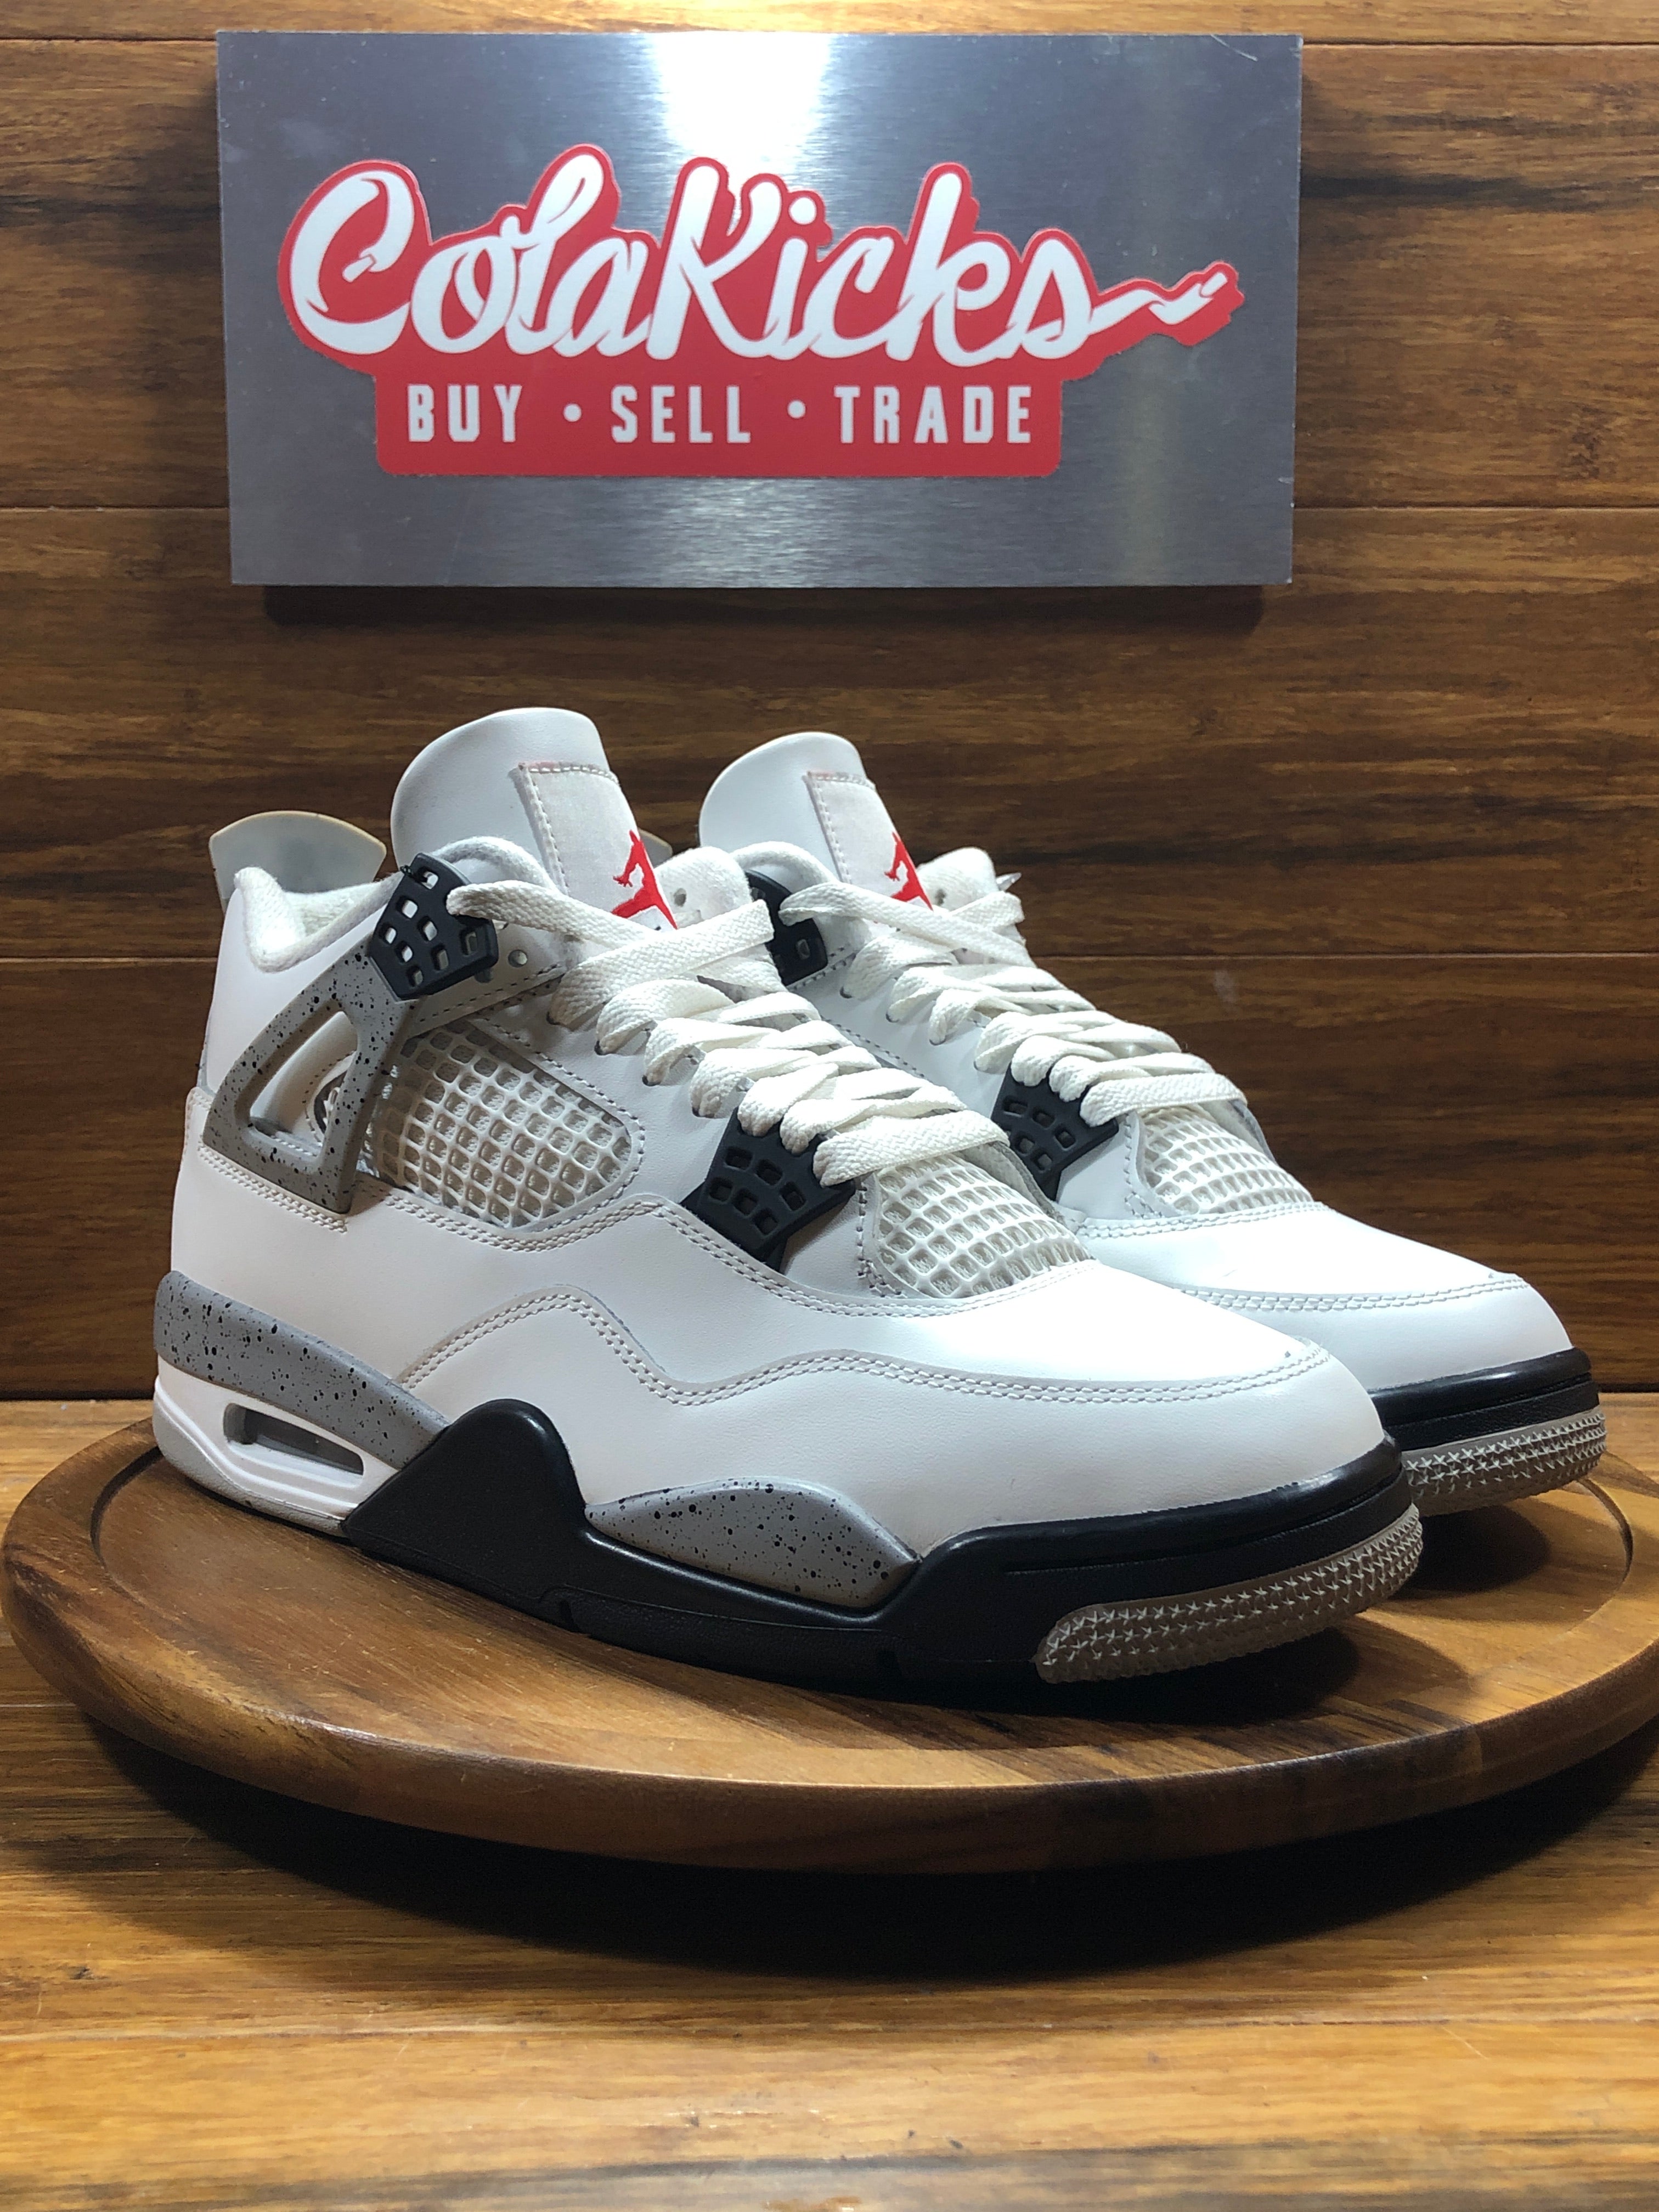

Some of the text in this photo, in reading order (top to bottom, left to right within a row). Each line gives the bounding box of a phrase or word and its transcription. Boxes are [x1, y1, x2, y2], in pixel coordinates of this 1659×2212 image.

[290, 153, 1227, 367] ColaKicks
[408, 384, 1031, 444] BUY SELL TRADE
